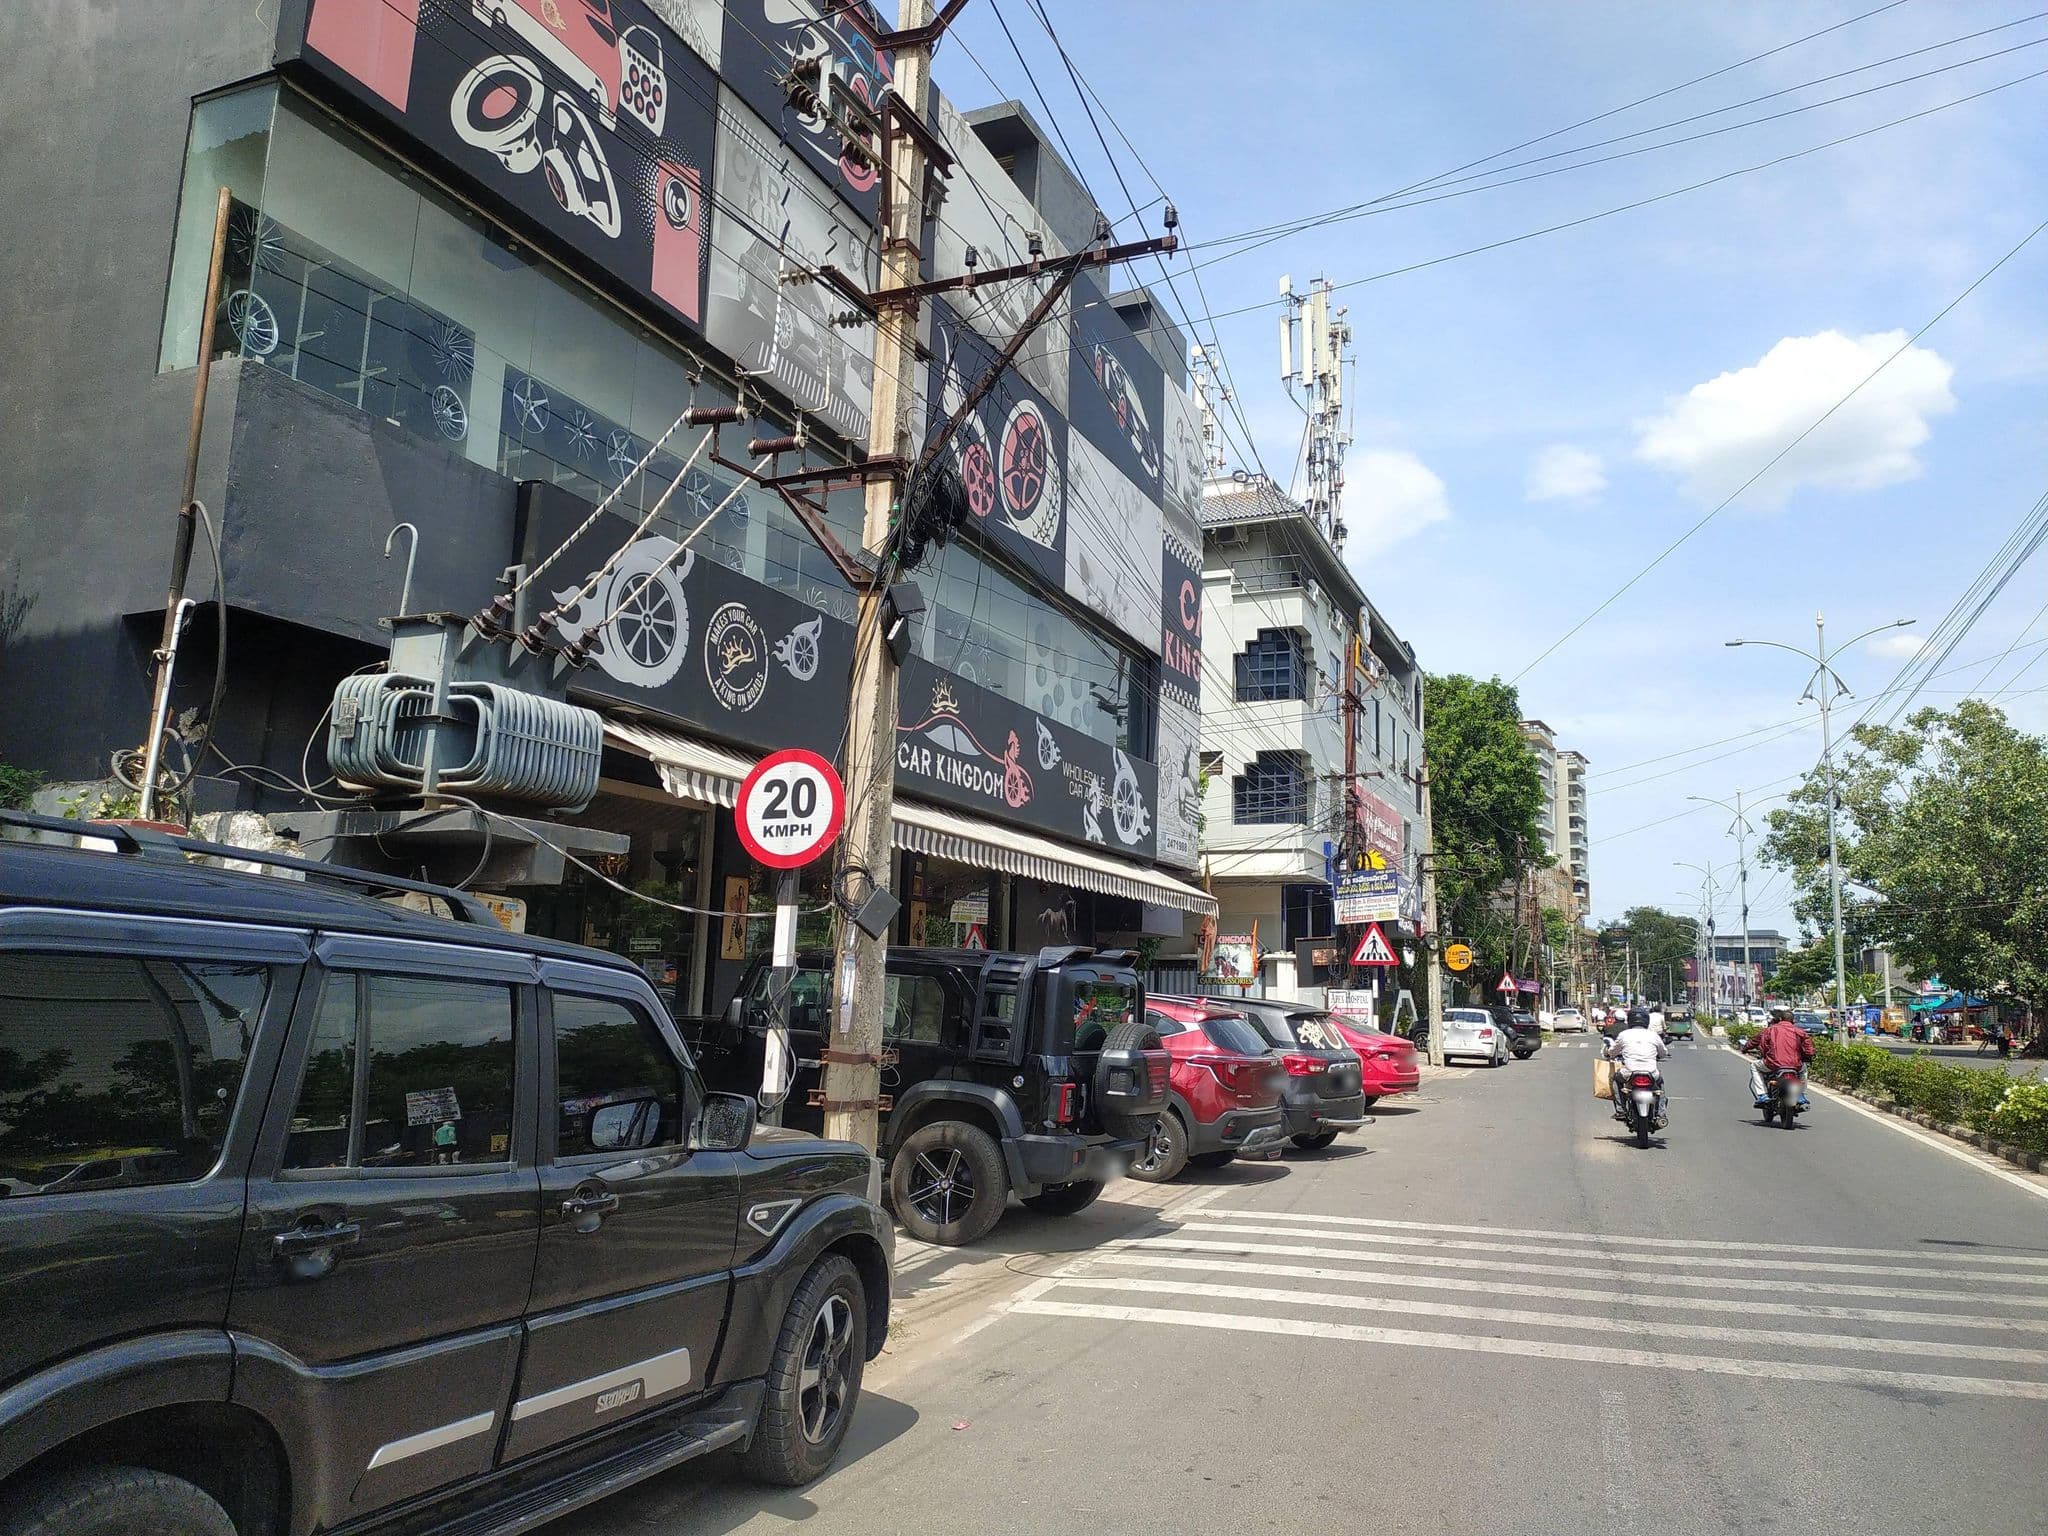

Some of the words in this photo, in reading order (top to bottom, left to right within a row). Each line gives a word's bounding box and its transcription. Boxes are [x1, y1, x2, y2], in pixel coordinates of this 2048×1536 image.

[732, 147, 781, 217] CAR
[710, 613, 729, 645] MAKES
[727, 609, 745, 624] YOUR
[745, 615, 758, 636] CAR
[720, 683, 737, 705] KING
[737, 694, 747, 706] ON
[746, 671, 764, 702] ROADS
[897, 742, 931, 777] CAR
[936, 753, 1004, 799] KINGDOM
[1062, 761, 1105, 792] WHOLESALE
[762, 777, 817, 820] 20
[1069, 781, 1084, 799] CAR
[763, 823, 812, 838] KMPH
[1216, 935, 1252, 944] KINGDOM
